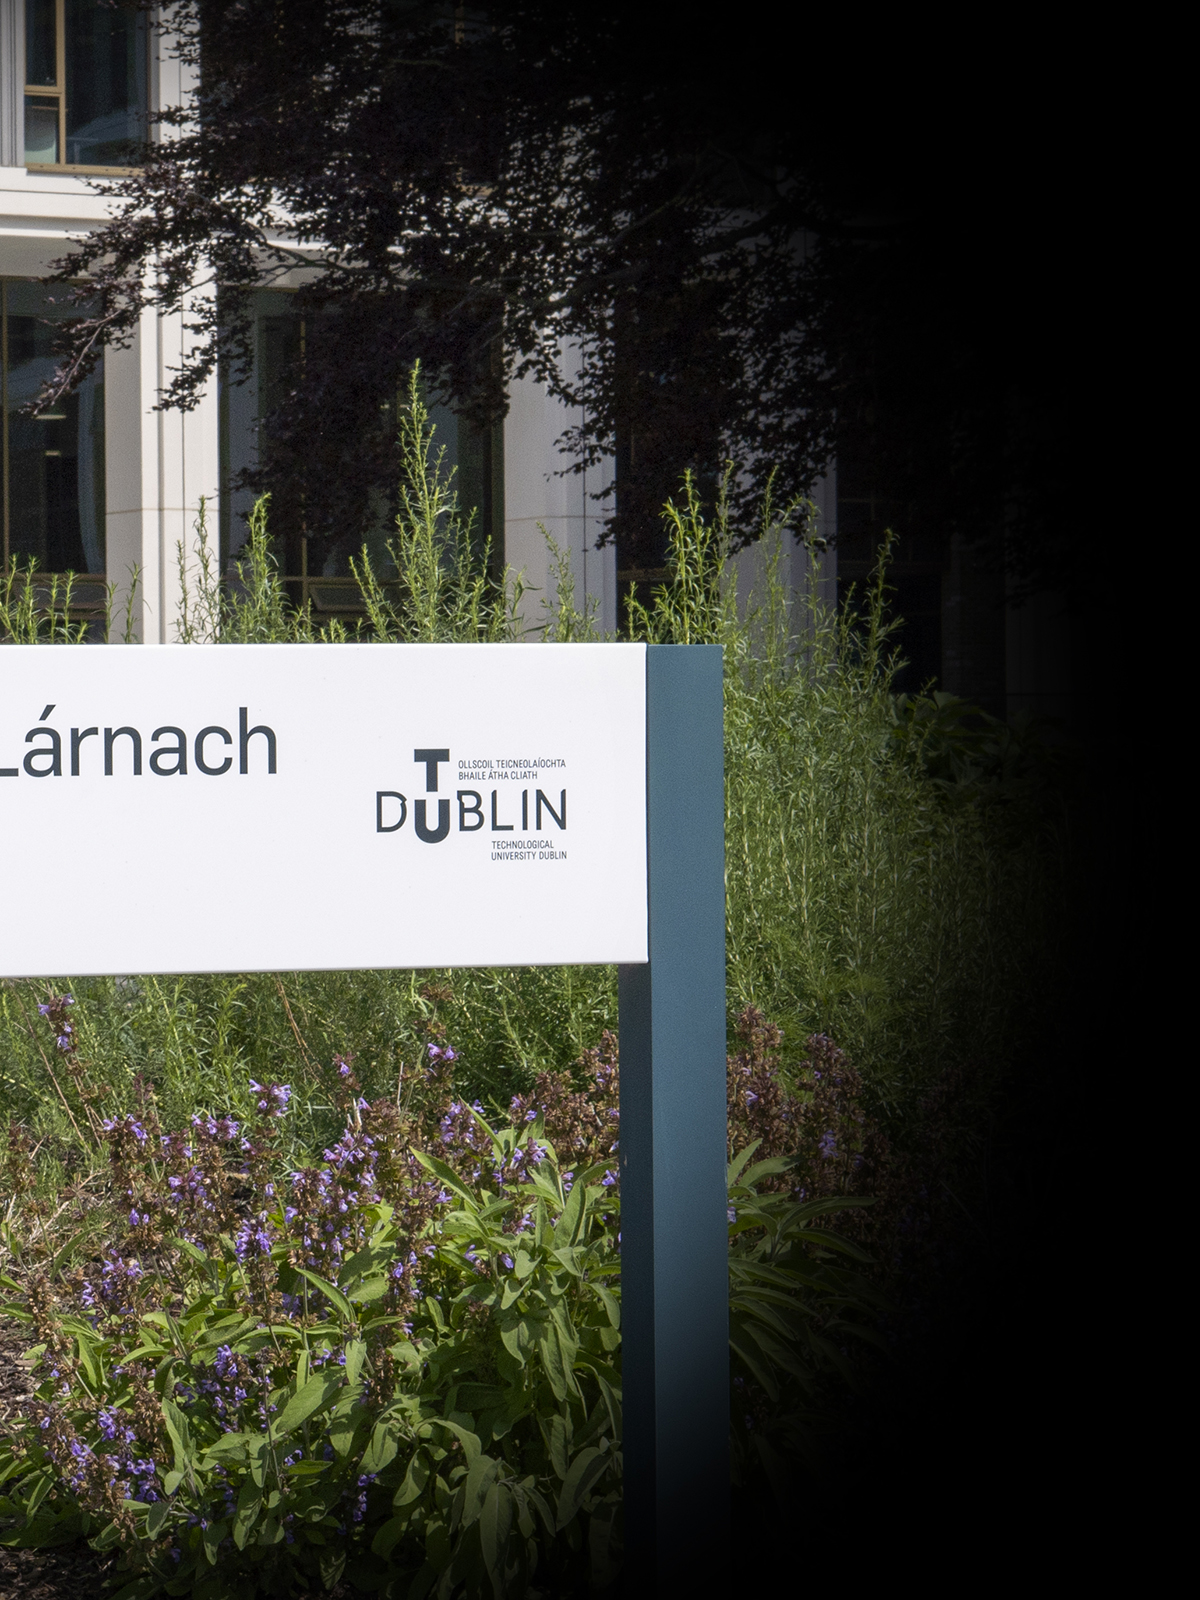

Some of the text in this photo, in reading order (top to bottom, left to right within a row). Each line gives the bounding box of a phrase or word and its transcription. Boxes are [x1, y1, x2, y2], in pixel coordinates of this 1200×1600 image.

[458, 757, 566, 769] OLLSCOIL TEICNEOLAÍOCHTA
[458, 769, 538, 780] BHAILE ÁTHA CLIATH
[491, 840, 554, 850] TECHNOLOGICAL
[491, 850, 567, 861] UNIVERSITY DUBLIN
